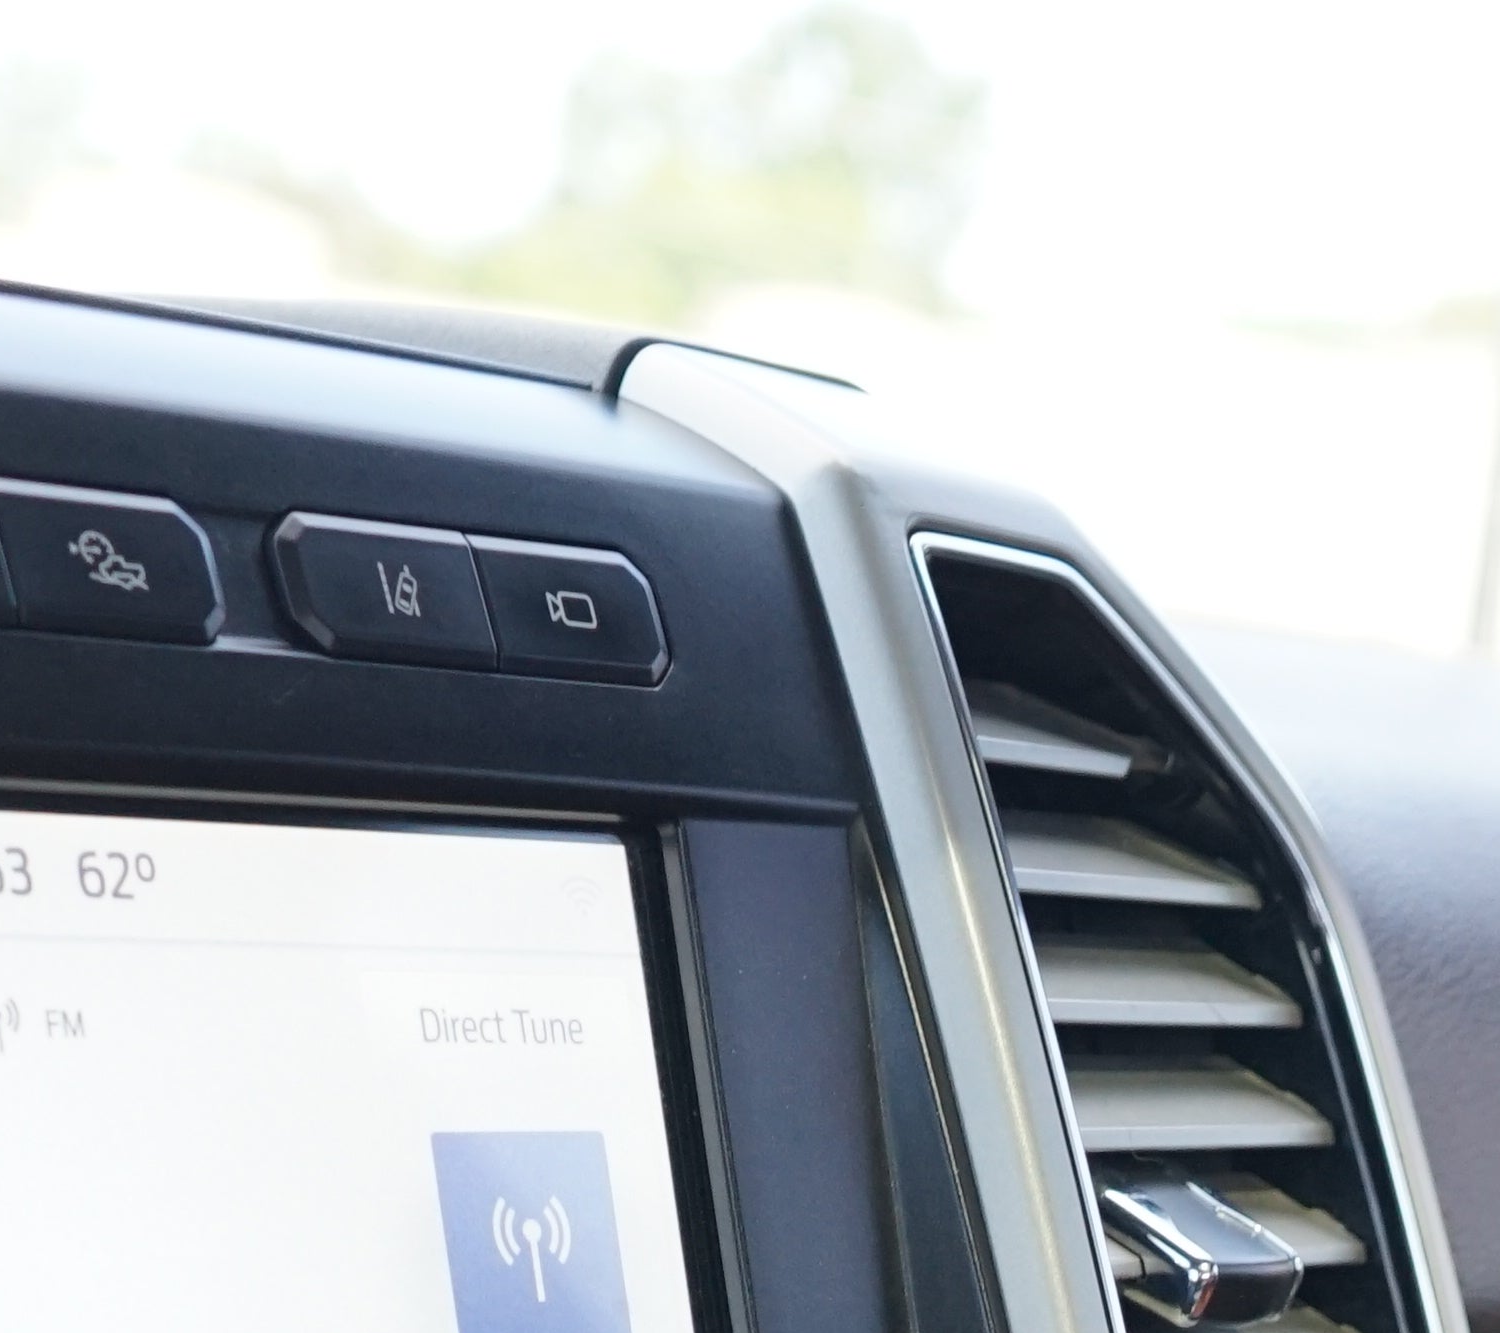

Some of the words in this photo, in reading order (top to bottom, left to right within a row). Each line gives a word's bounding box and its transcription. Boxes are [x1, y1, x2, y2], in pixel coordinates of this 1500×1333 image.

[45, 1010, 85, 1040] FM
[419, 1008, 505, 1045] Direct
[513, 1008, 584, 1046] Tune
